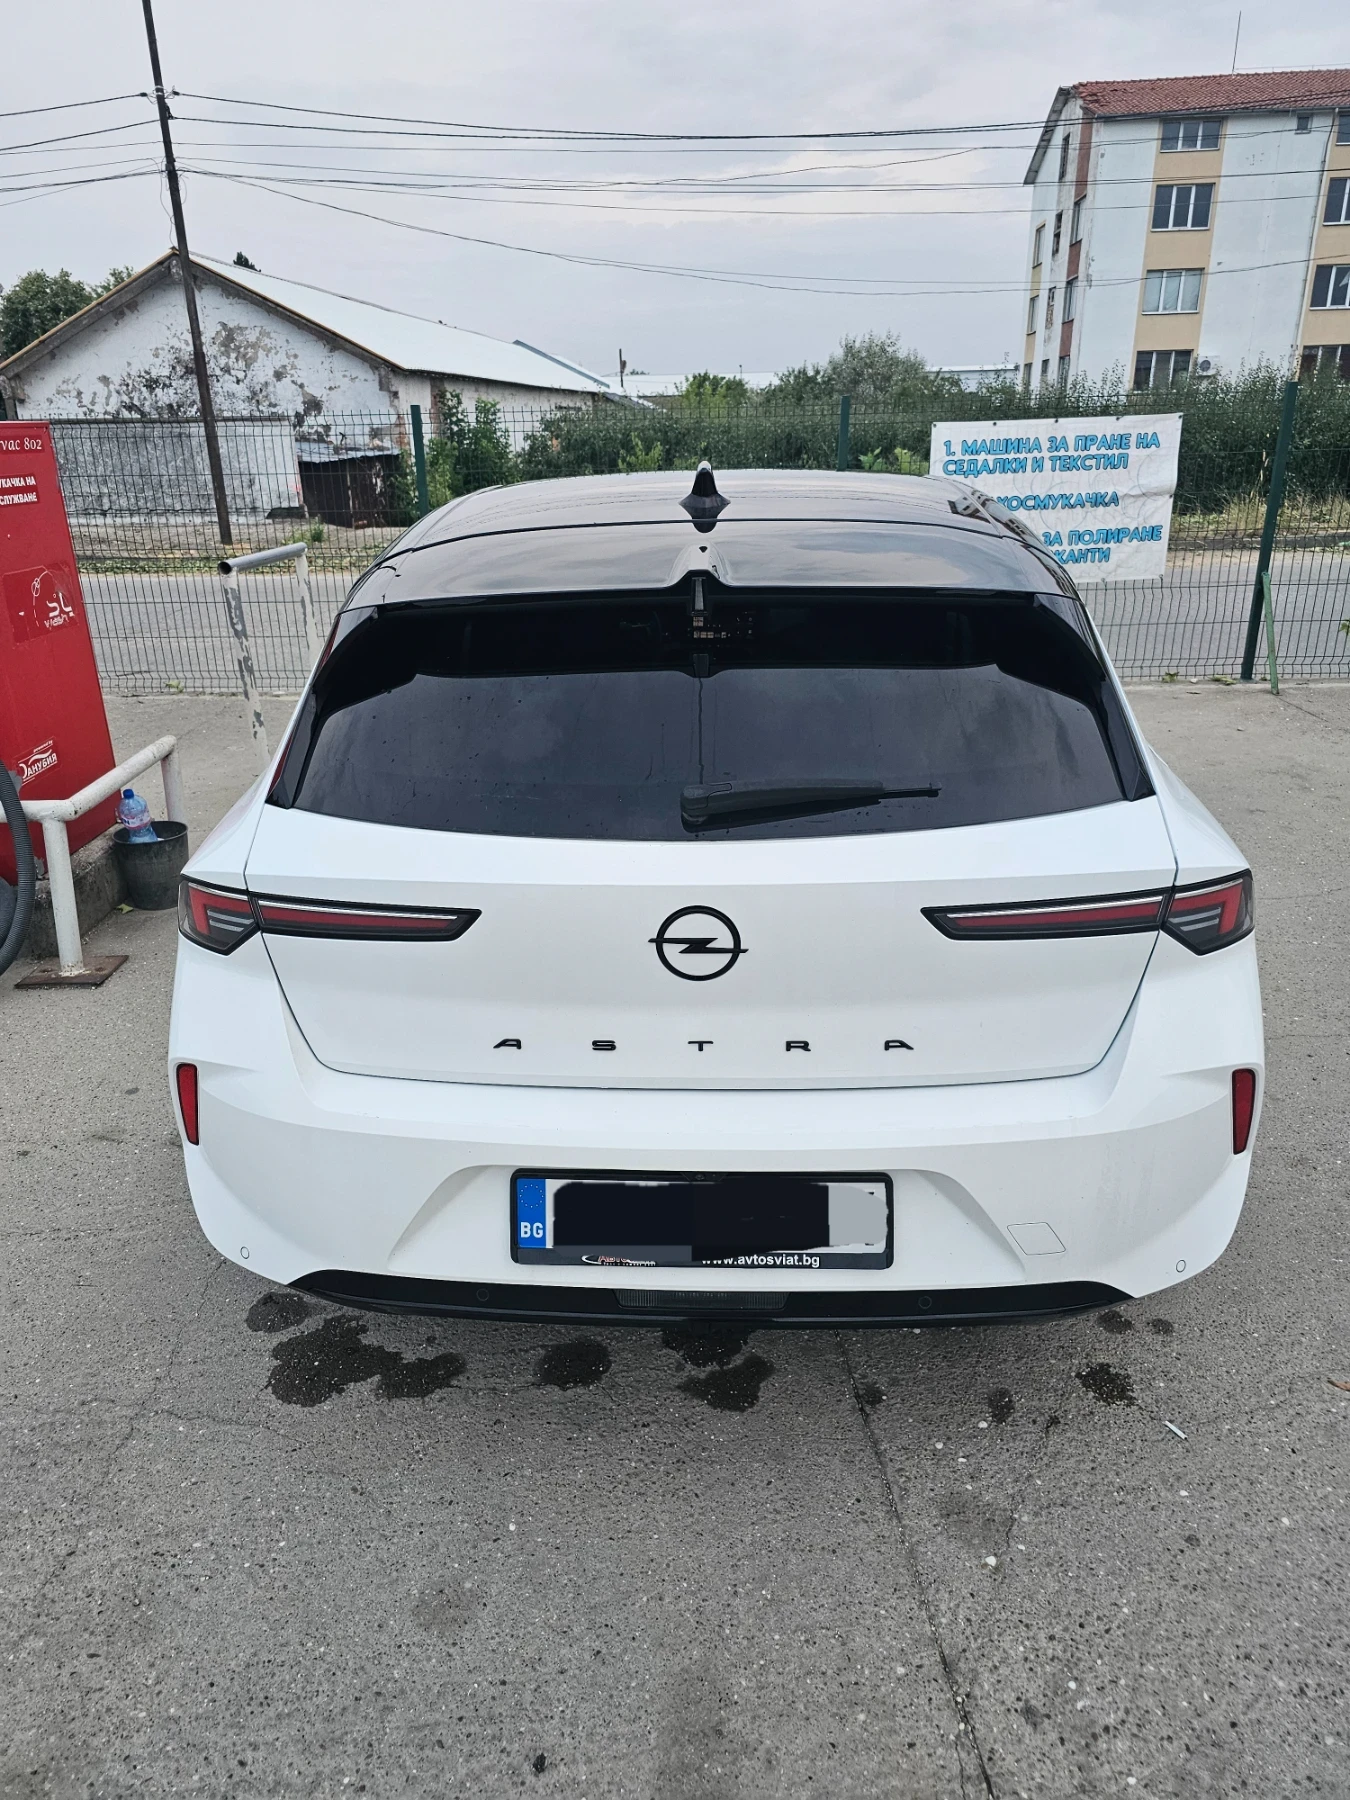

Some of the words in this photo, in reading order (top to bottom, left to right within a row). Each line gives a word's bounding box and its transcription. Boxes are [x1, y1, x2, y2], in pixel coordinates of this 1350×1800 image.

[24, 437, 42, 450] 802
[943, 440, 955, 456] 1.
[961, 437, 1042, 456] МАШИНА
[1047, 435, 1069, 452] ЗА
[1074, 433, 1131, 451] ПРАНЕ
[1136, 432, 1160, 449] НА
[943, 457, 1027, 478] СЕДАЛКИ
[1032, 456, 1044, 473] И
[1050, 453, 1129, 472] ТЕКСТИЛ
[26, 476, 36, 486] НА
[1068, 525, 1163, 546] ПОЛИРАНЕ
[493, 1038, 914, 1052] ASTRA
[520, 1221, 543, 1238] BG
